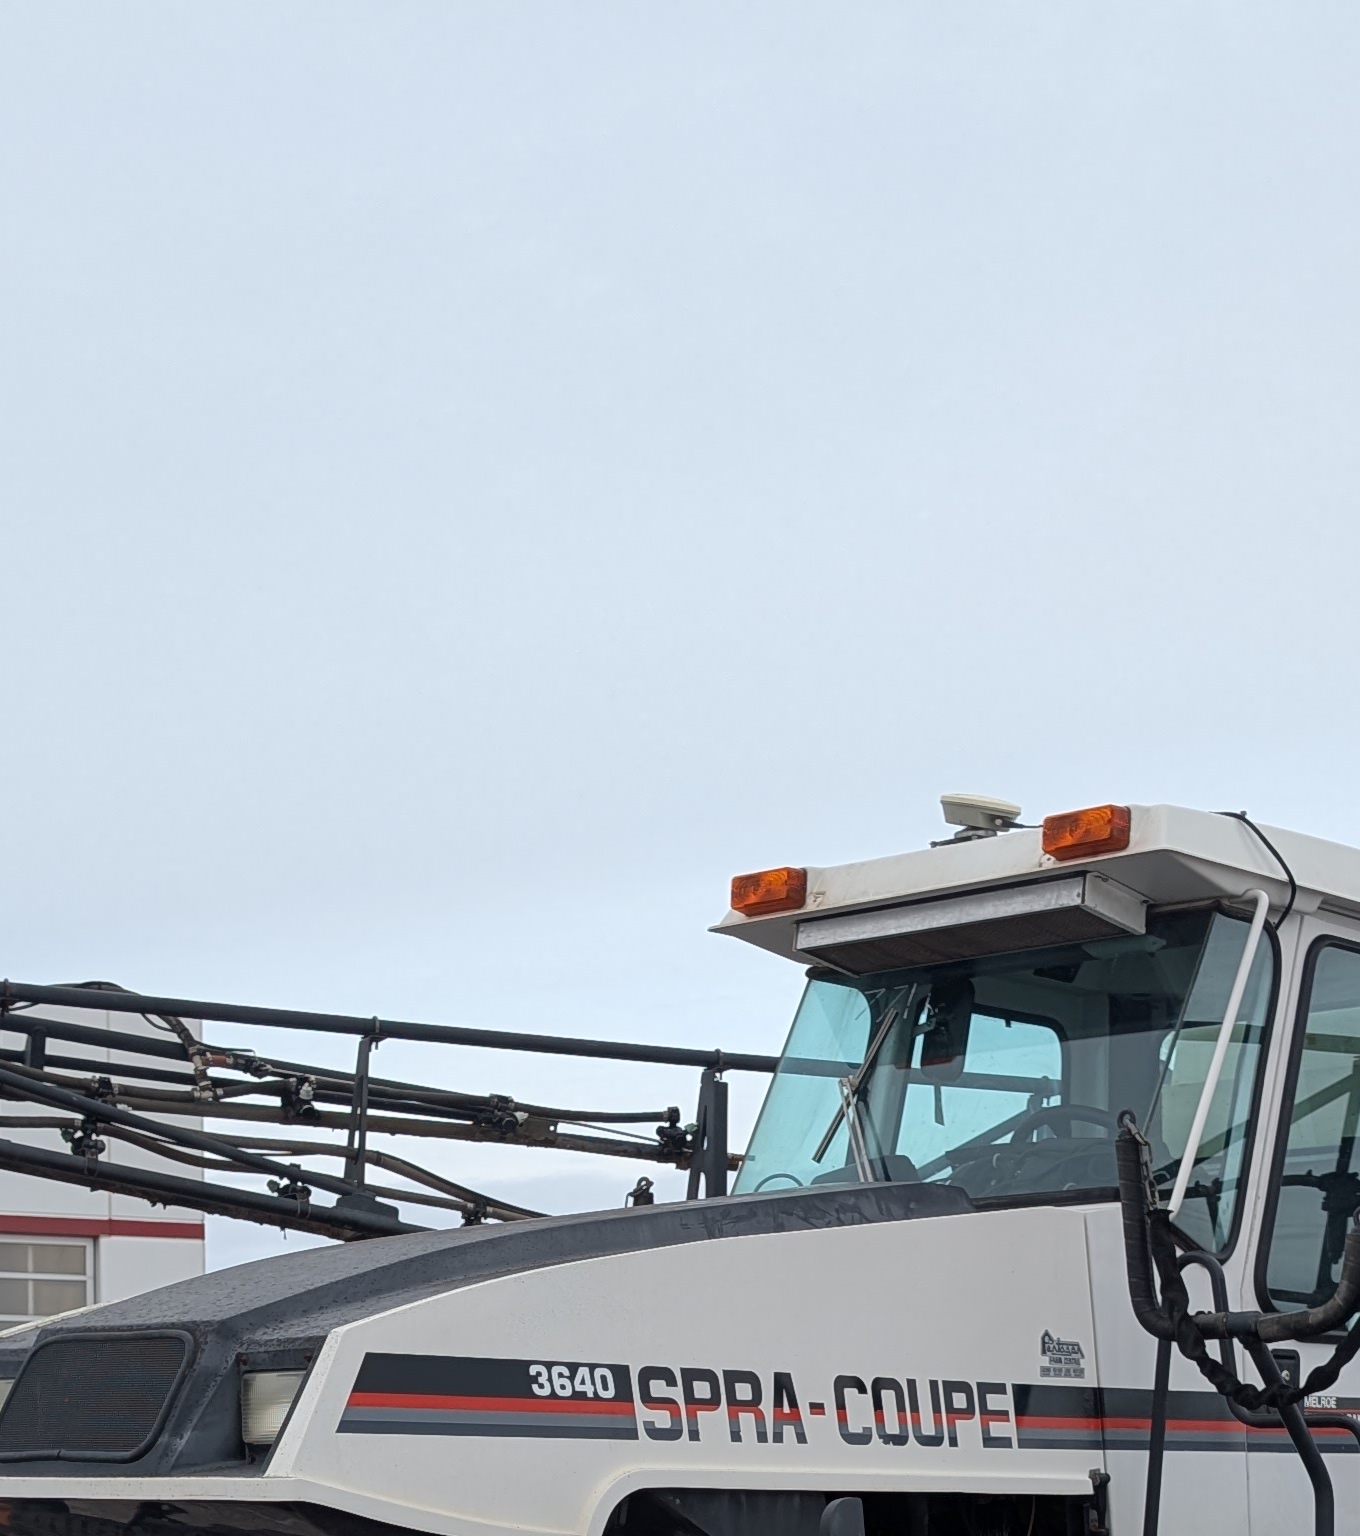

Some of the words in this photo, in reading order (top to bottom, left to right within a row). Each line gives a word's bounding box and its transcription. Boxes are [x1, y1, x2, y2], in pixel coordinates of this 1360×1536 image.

[529, 1364, 616, 1399] 3640
[637, 1365, 1014, 1450] SPRA-COUPE
[1303, 1396, 1338, 1409] MELROE
